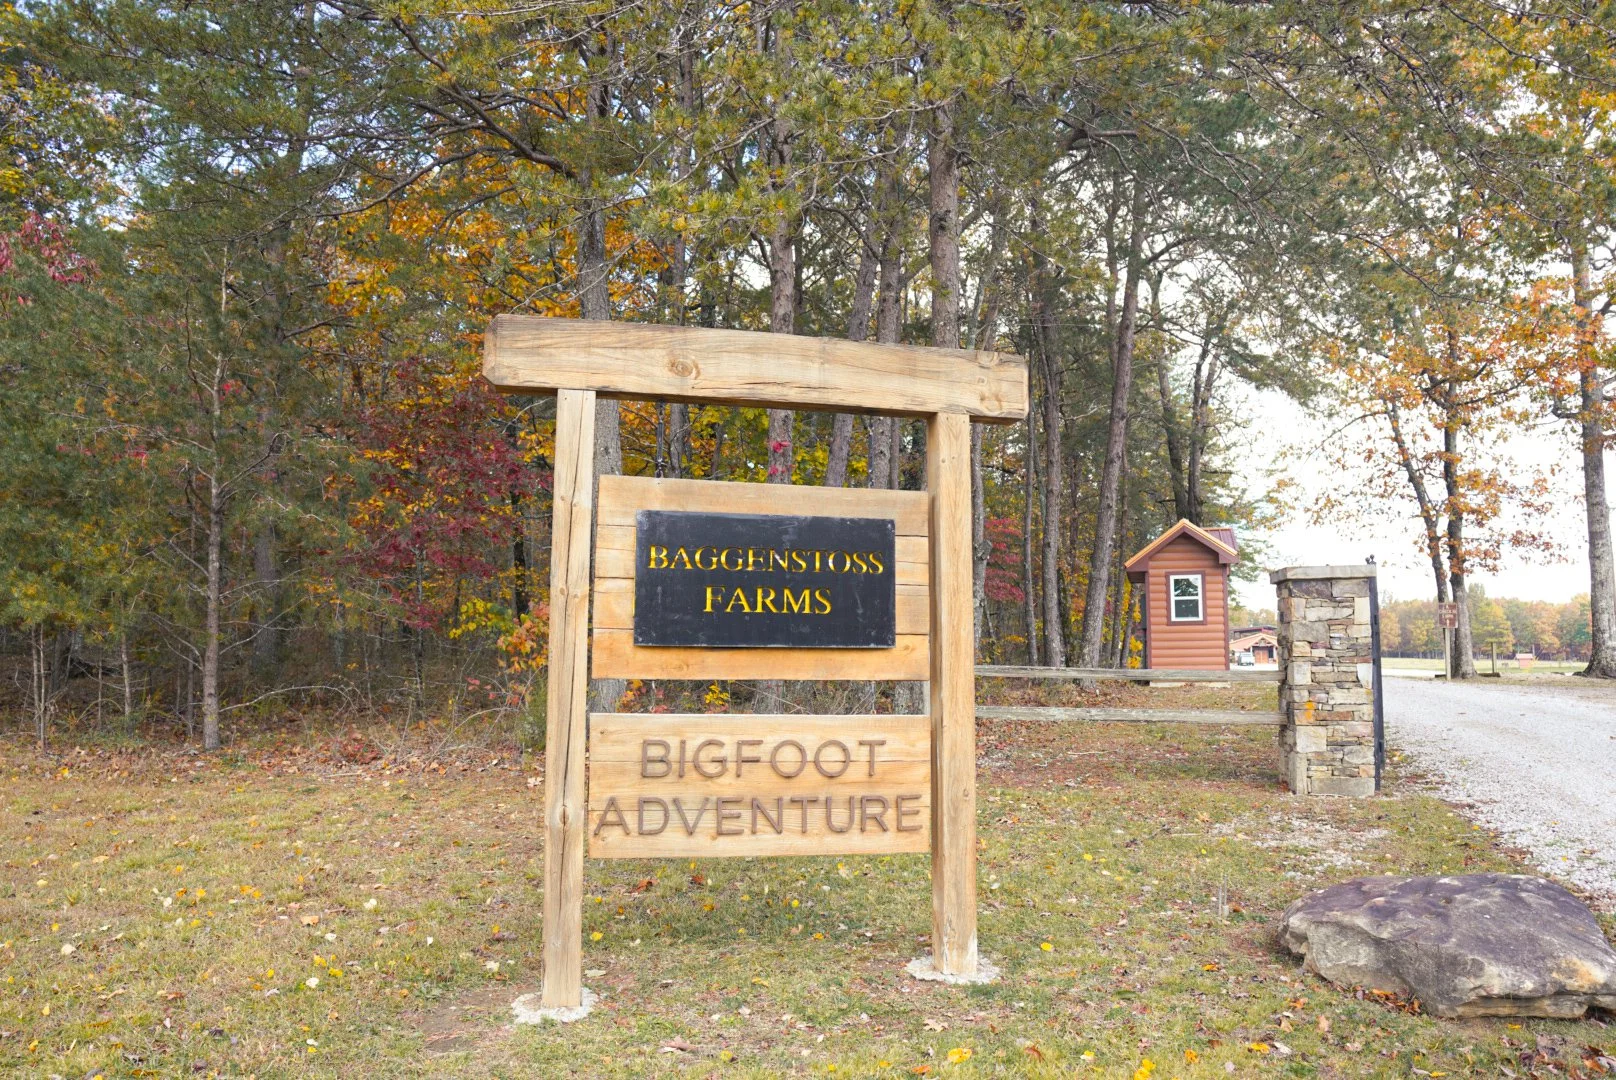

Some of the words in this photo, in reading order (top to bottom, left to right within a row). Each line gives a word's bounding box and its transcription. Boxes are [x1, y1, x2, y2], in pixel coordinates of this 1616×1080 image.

[648, 545, 884, 574] BAGGENSTOSS
[703, 585, 832, 615] FARMS
[641, 739, 886, 778] BIGFOOT
[593, 795, 924, 835] ADVENTURE
